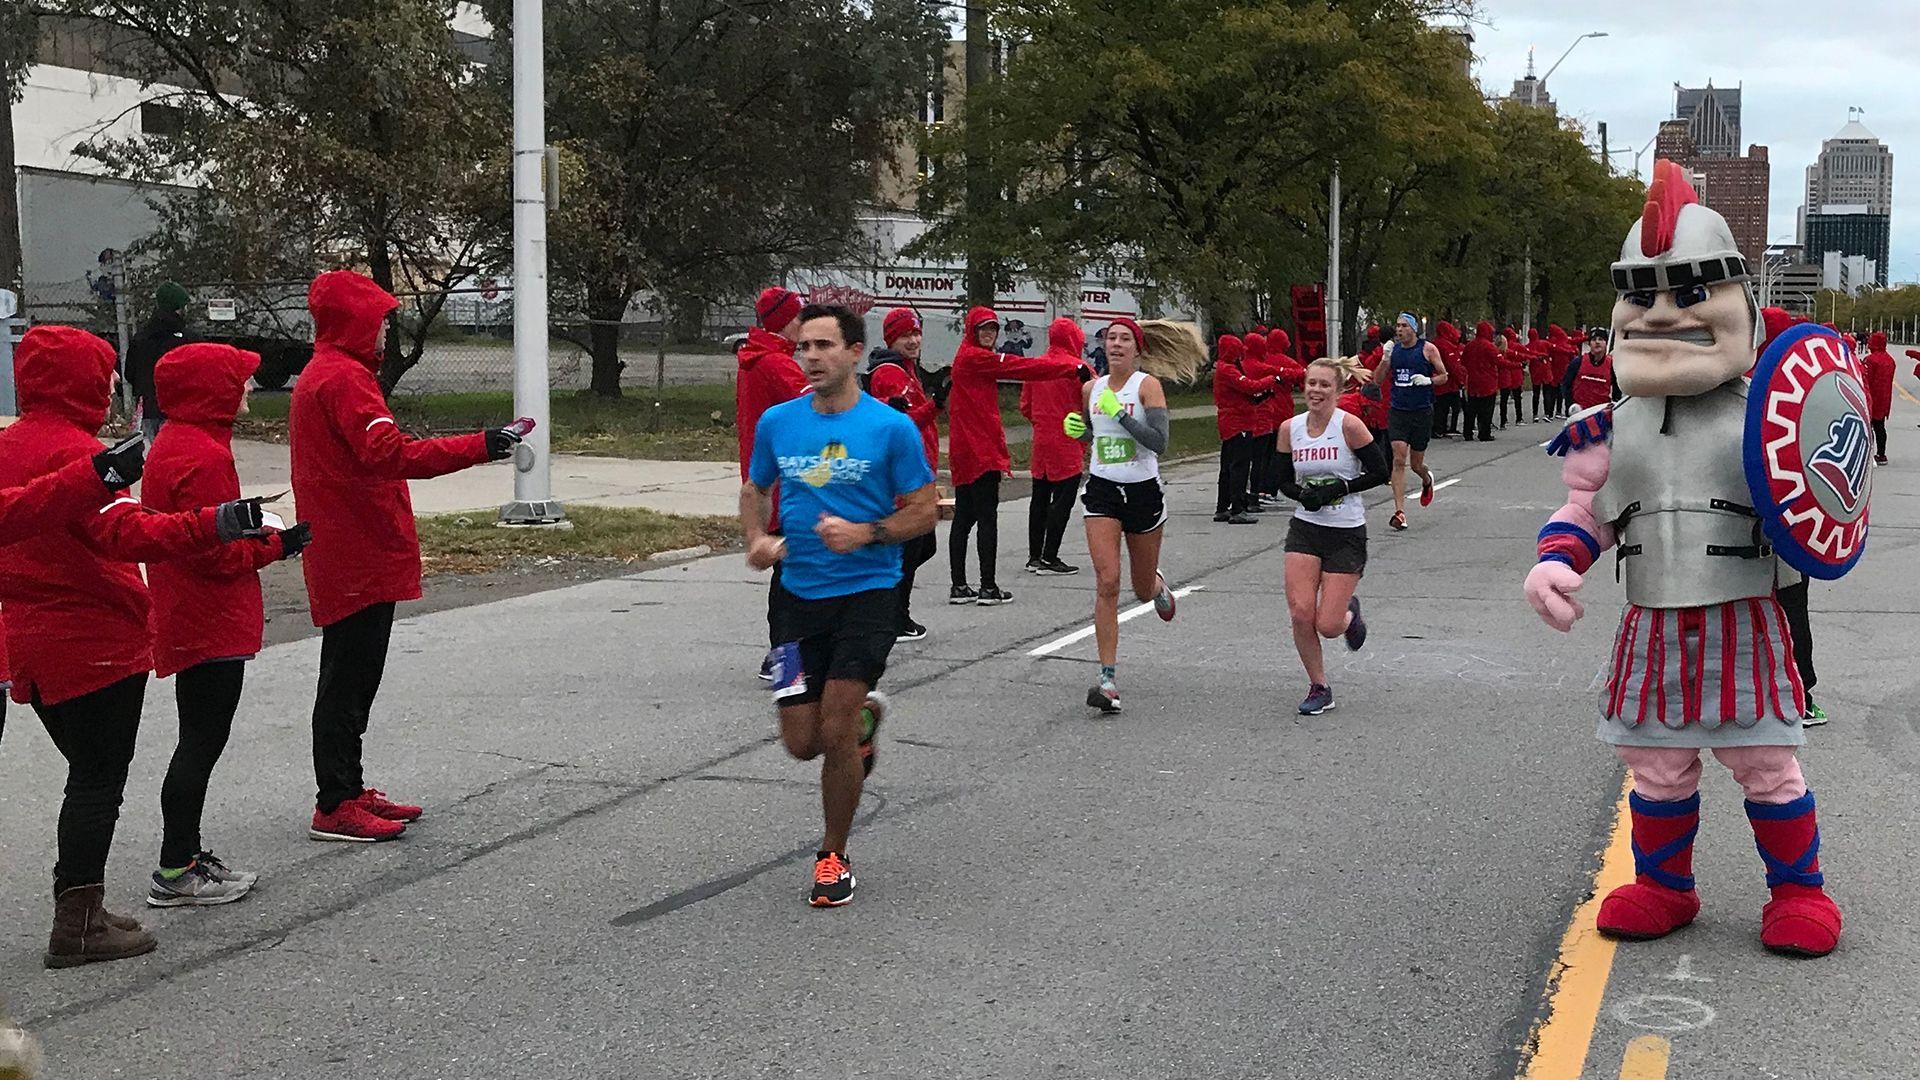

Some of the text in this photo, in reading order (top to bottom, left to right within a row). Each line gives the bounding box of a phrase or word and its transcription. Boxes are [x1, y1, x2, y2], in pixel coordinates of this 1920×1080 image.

[885, 276, 954, 291] DONATION
[816, 289, 833, 302] THE
[1293, 447, 1339, 462] DETROIT
